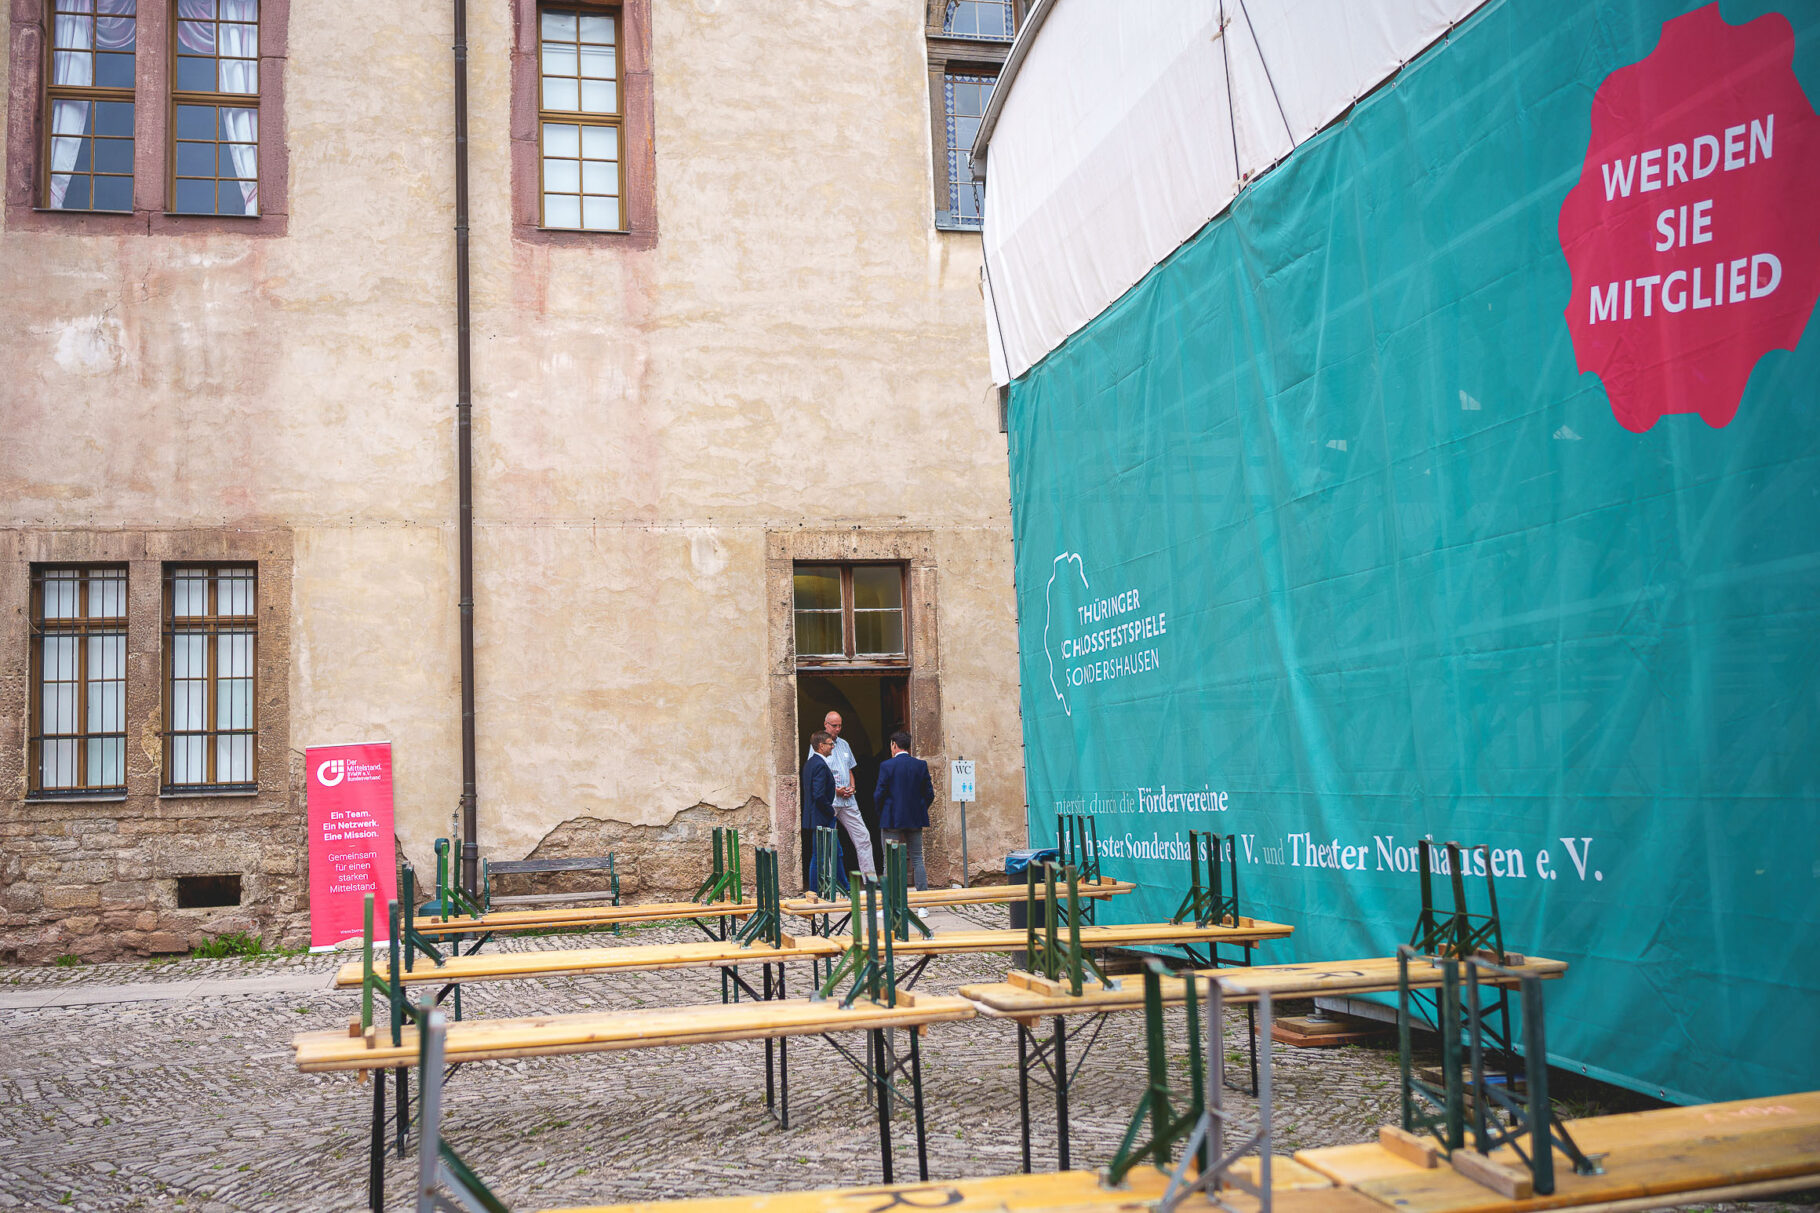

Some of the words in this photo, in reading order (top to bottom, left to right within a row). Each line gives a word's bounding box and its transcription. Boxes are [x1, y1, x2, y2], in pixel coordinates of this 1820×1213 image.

[1601, 113, 1774, 202] WERDEN
[1655, 199, 1713, 252] SIE
[1589, 253, 1783, 325] MITGLIED
[1078, 588, 1140, 625] THÜRINGER
[1065, 648, 1160, 687] SONDERSHAUSEN
[955, 765, 971, 775] WC
[1120, 791, 1136, 814] die
[1137, 783, 1229, 814] Fördervereine
[330, 811, 344, 820] Ein
[345, 810, 371, 818] Team.
[323, 822, 336, 830] Ein
[338, 819, 379, 829] Netzwerk.
[324, 832, 342, 841] Eine
[344, 830, 379, 839] Mission.
[328, 851, 377, 862] Gemeinsam
[1241, 834, 1259, 864] V.
[1262, 838, 1286, 866] und
[1287, 831, 1369, 871] Theater
[1535, 848, 1557, 880] e.
[1560, 837, 1603, 881] V.
[335, 862, 347, 872] für
[348, 862, 371, 871] einen
[338, 872, 369, 882] starken
[329, 881, 378, 893] Mittelstand.
